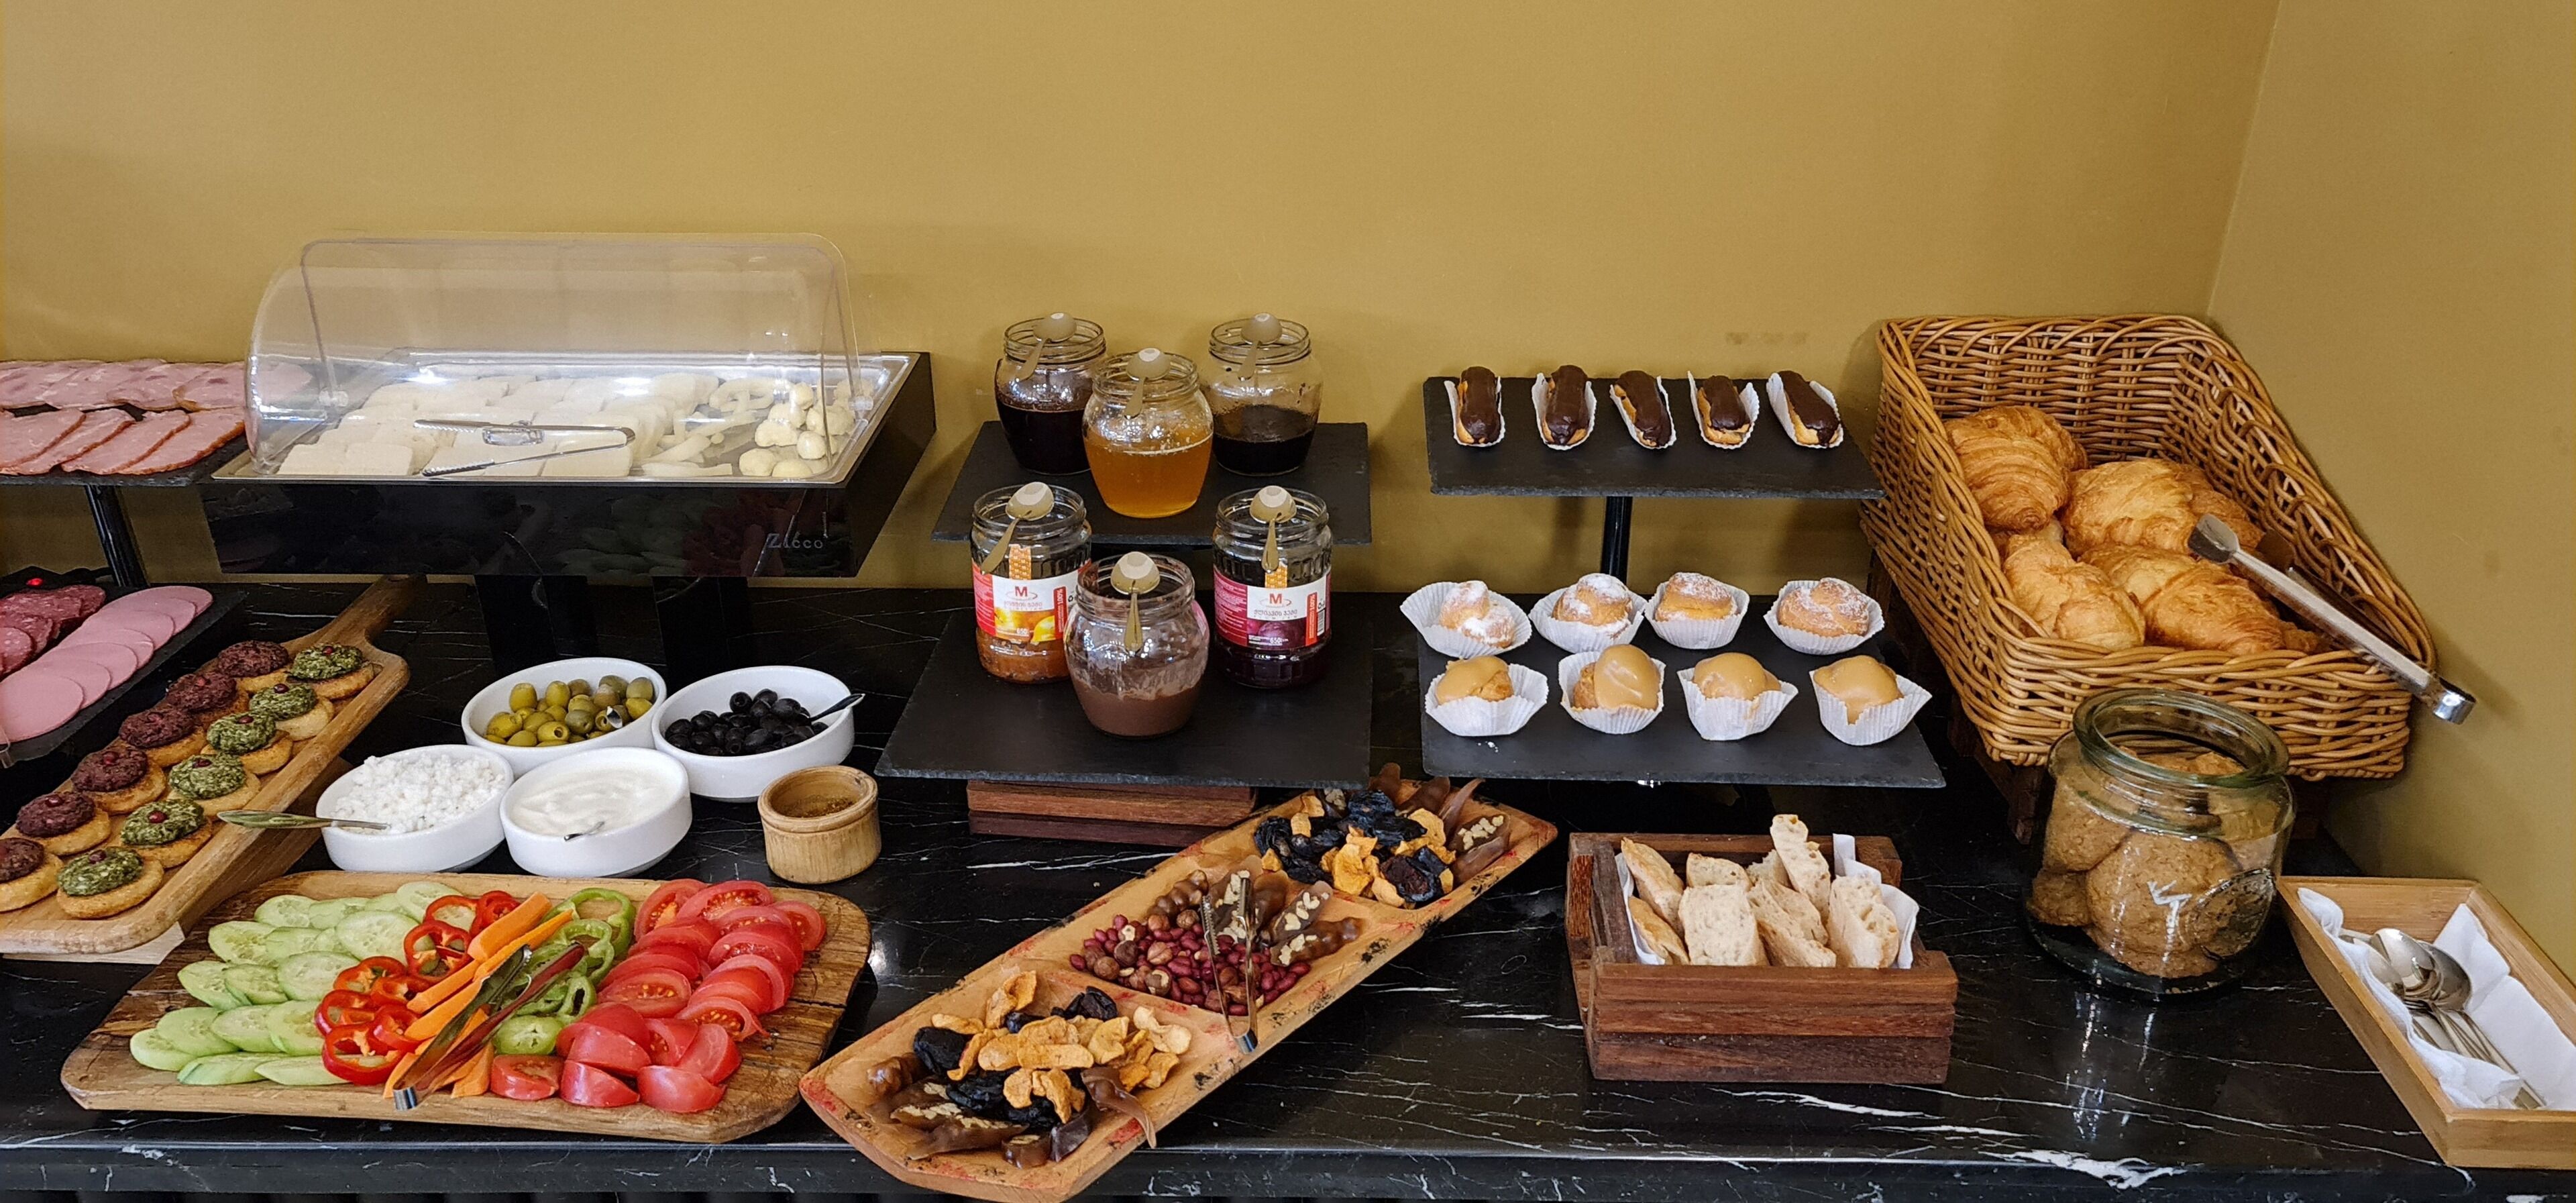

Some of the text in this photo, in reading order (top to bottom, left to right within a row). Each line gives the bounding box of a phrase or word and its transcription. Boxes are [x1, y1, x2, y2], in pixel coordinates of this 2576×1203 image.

[767, 533, 823, 548] Zicco
[1015, 586, 1028, 596] M
[1269, 594, 1282, 604] M
